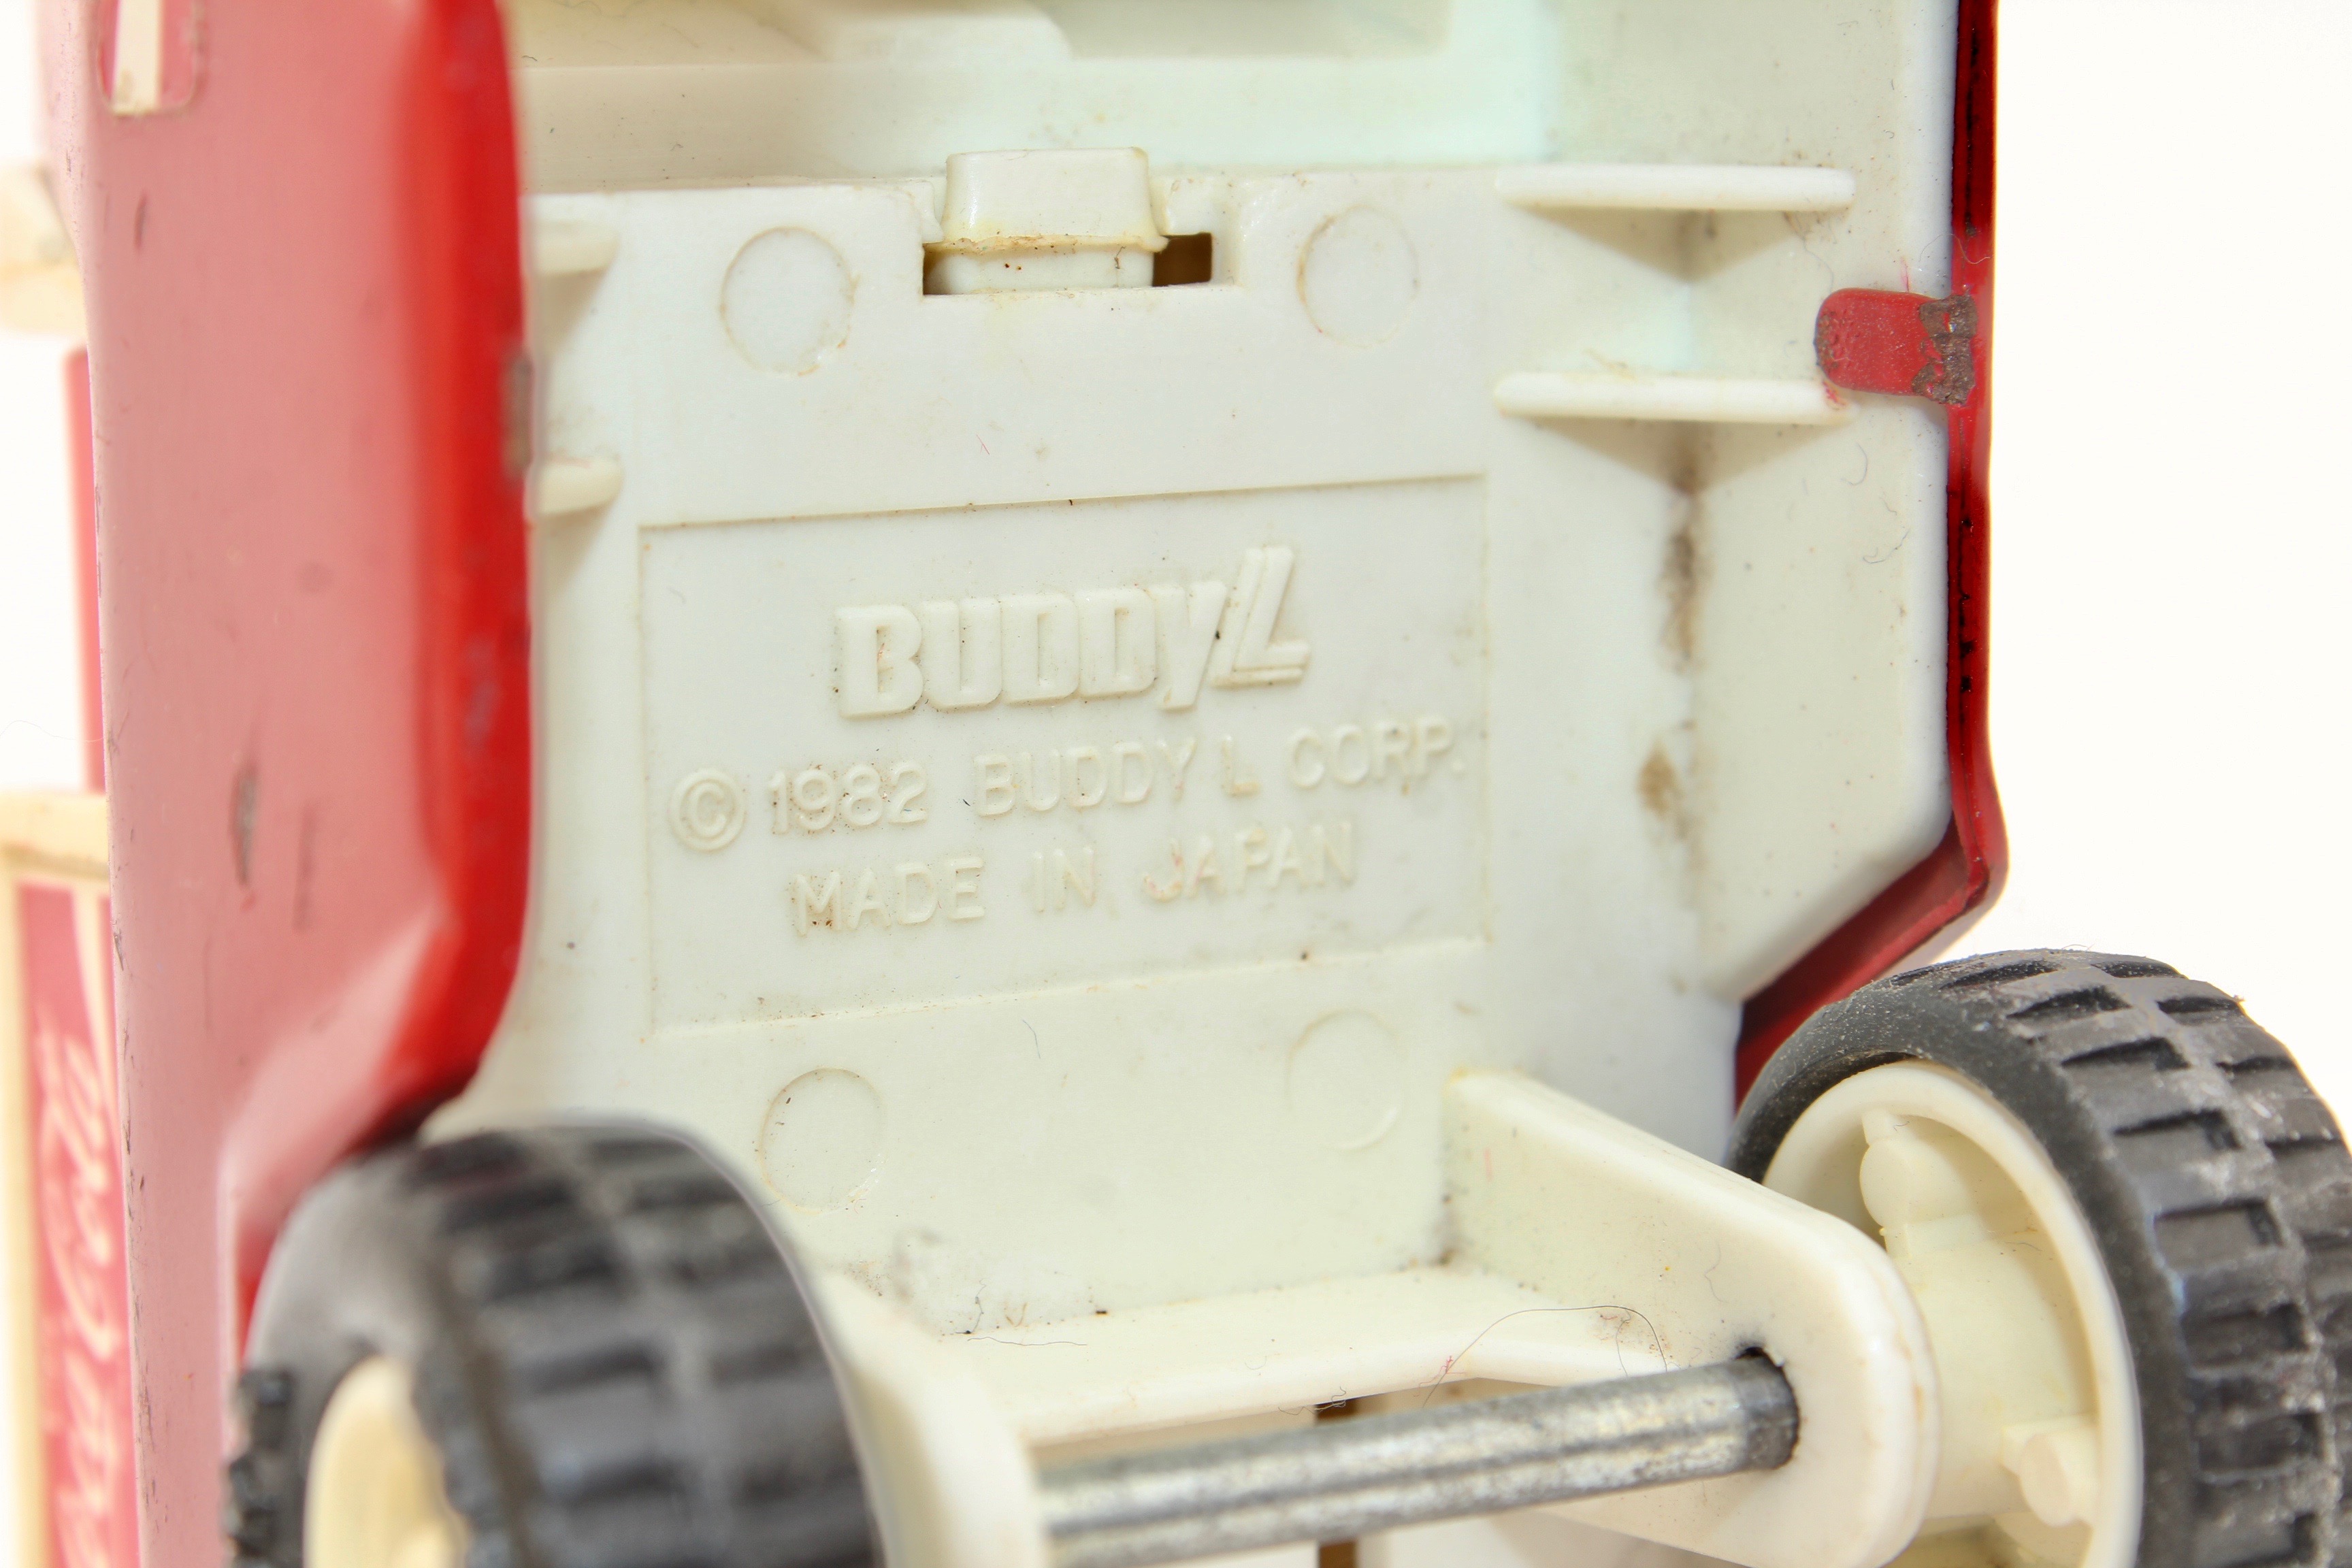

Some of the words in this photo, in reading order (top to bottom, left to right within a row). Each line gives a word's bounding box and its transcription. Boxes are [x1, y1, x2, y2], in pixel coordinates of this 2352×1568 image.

[769, 762, 930, 836] 1982
[975, 738, 1196, 818] BUDDY
[1220, 735, 1259, 796] L
[1288, 716, 1466, 789] CORP.
[794, 856, 986, 935] MADE
[1034, 848, 1097, 913] IN
[1144, 822, 1354, 902] JAPAN
